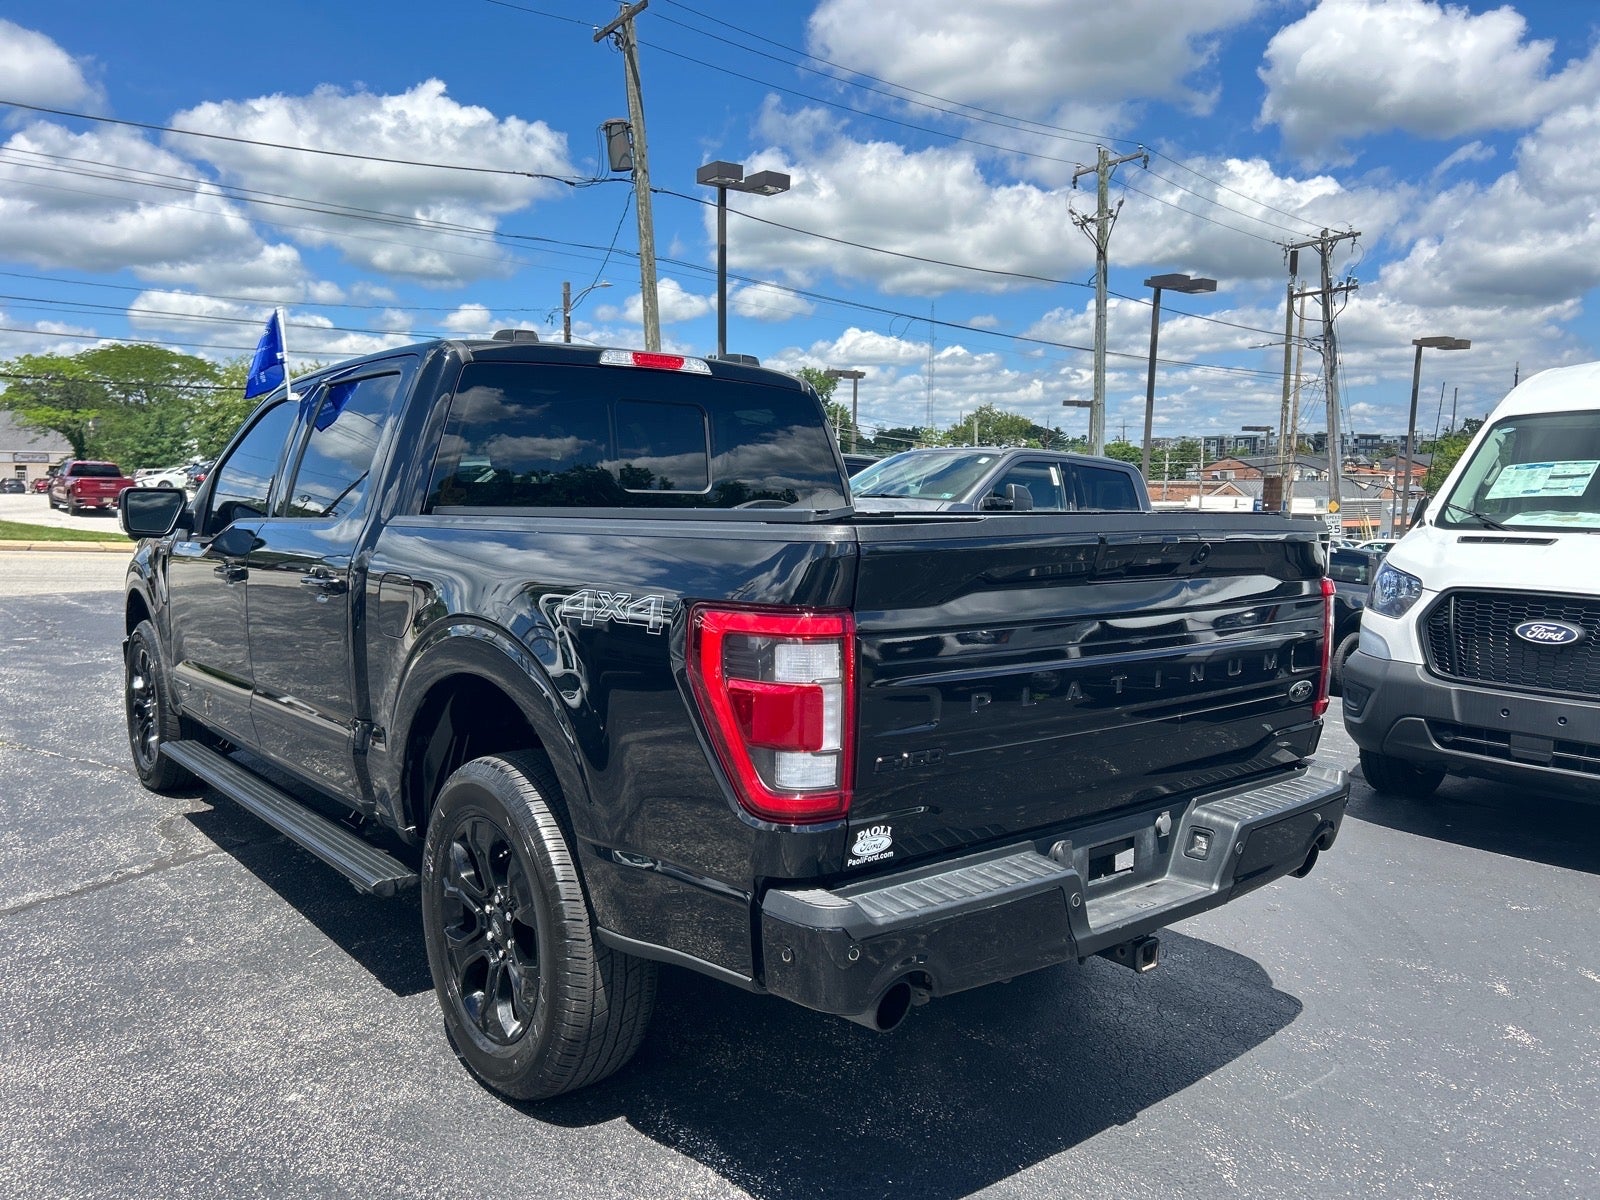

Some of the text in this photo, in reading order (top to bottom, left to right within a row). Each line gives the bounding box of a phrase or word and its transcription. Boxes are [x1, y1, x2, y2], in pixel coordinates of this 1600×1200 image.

[1328, 525, 1340, 533] 25
[1526, 624, 1567, 641] Ford
[970, 653, 1278, 714] PLATINUM
[856, 825, 892, 843] PAOLI
[859, 838, 885, 852] Ford
[847, 851, 894, 867] PaoliFord.com
